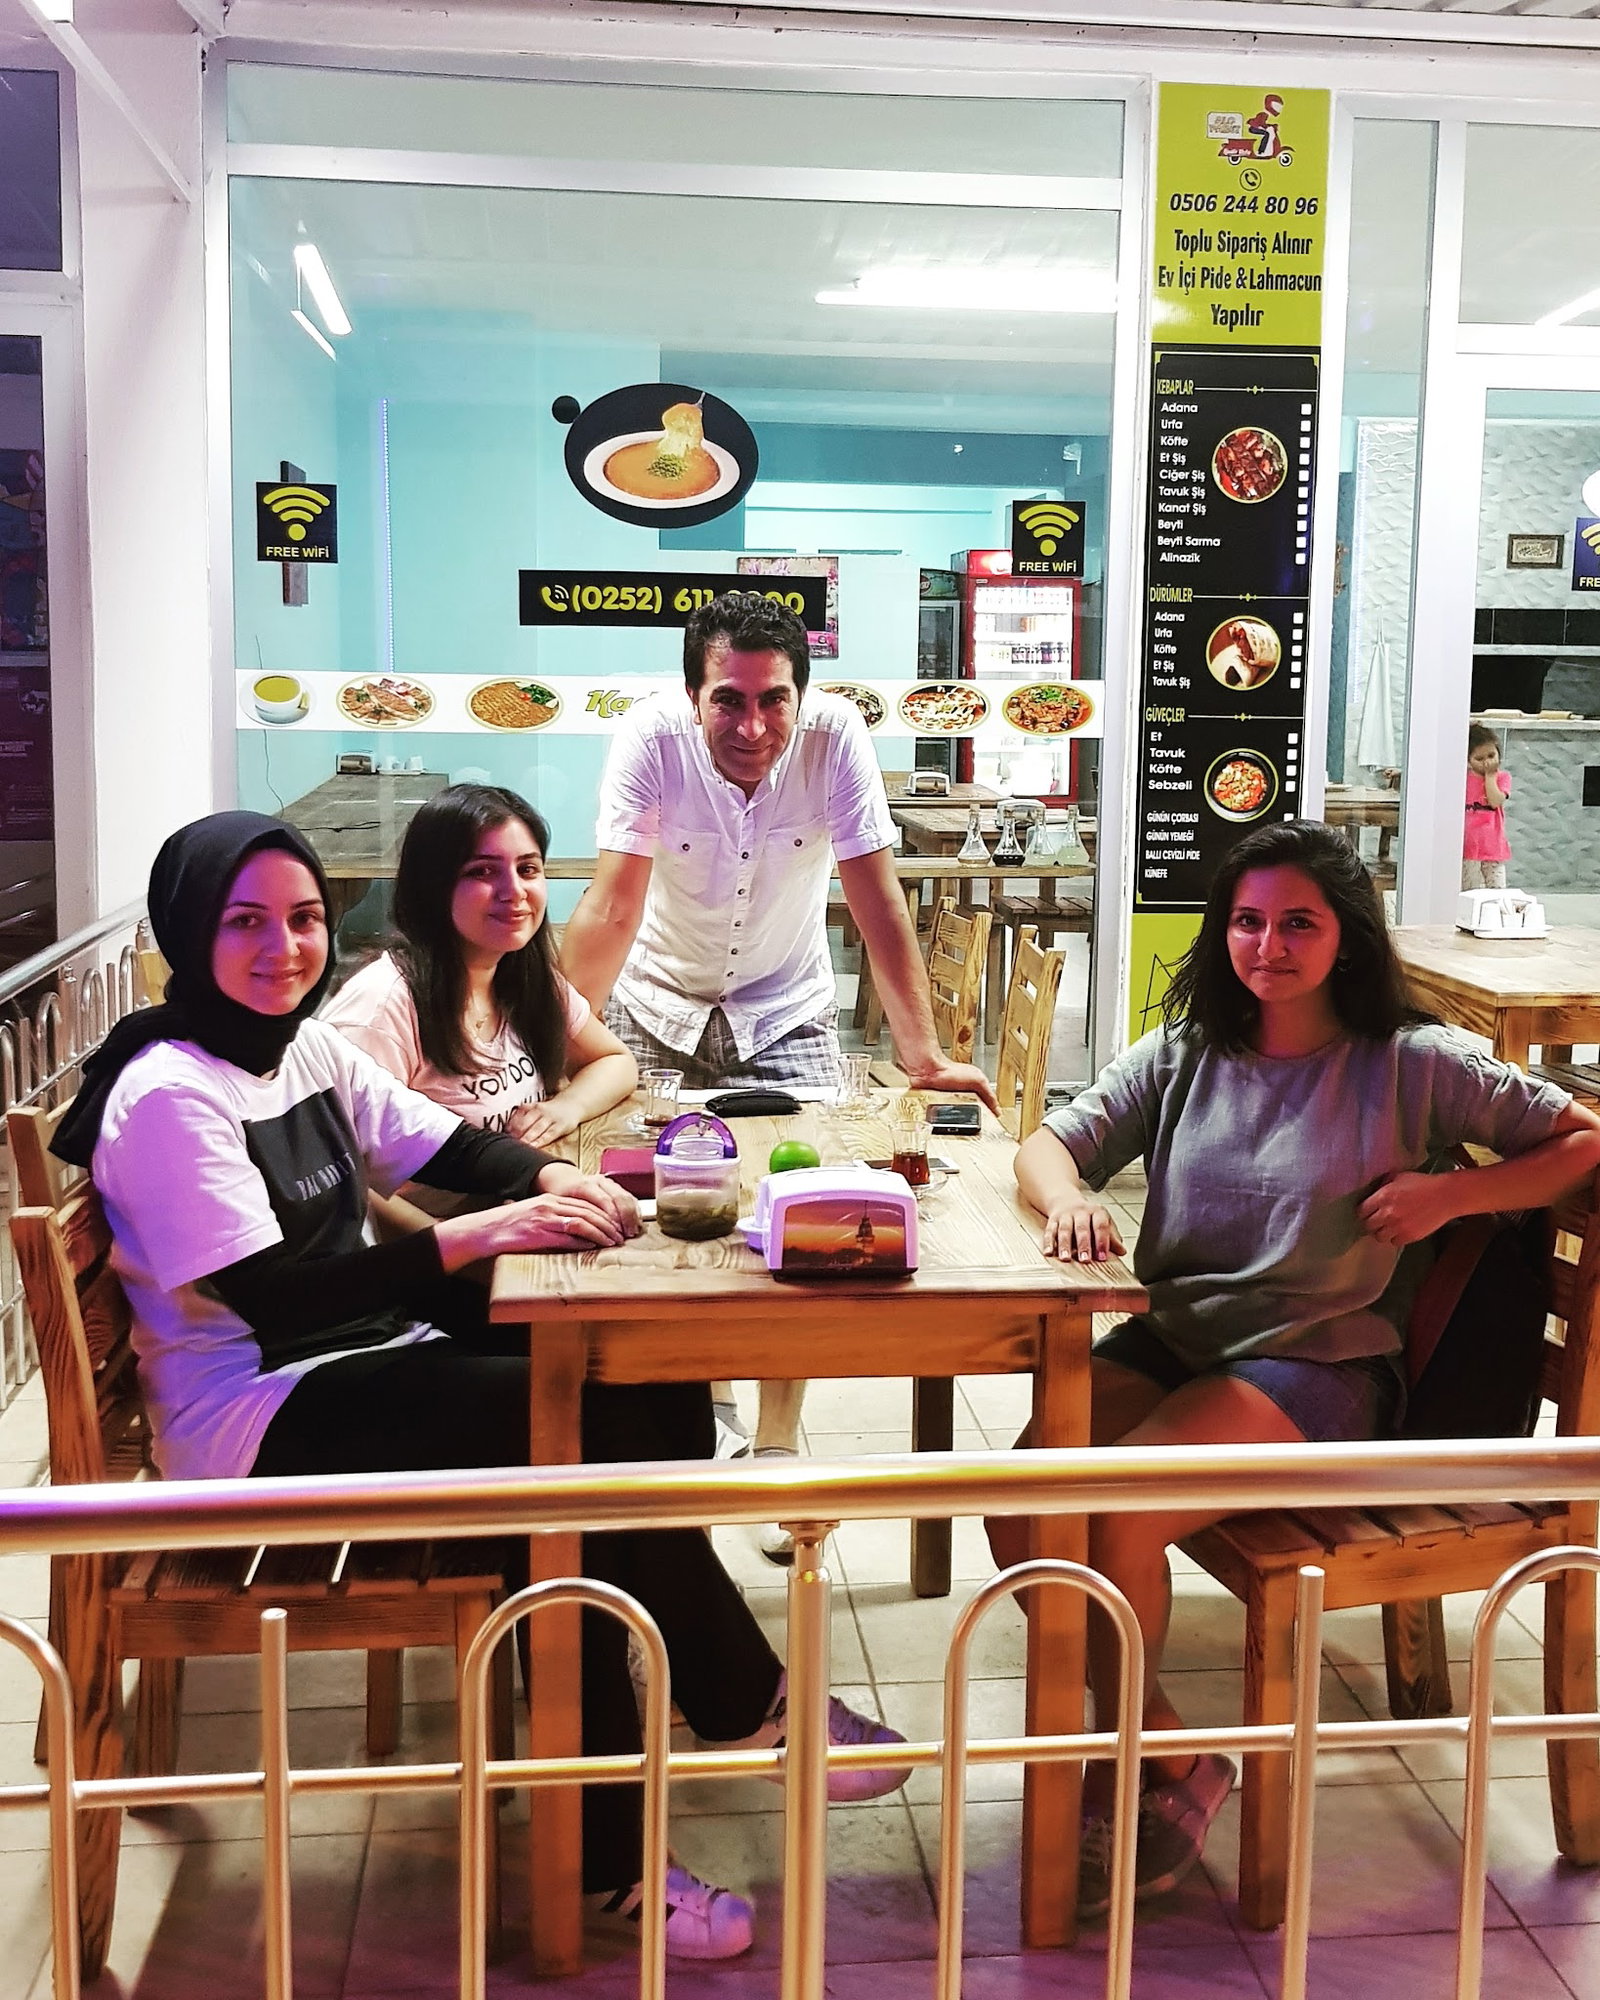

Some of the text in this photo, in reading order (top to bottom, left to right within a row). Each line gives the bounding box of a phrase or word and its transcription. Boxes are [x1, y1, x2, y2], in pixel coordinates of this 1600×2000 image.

[1170, 193, 1318, 216] 0506 244 80 96
[1174, 228, 1313, 261] Toplu Sipariş Alınır
[1158, 265, 1174, 288] Ev
[1201, 265, 1231, 290] Pide
[1211, 303, 1264, 332] Yapılır
[1156, 378, 1194, 395] KEBAPLAR
[1160, 402, 1199, 413] Adana
[1160, 419, 1183, 430] Urfa
[1160, 435, 1189, 447] Köfte
[1160, 452, 1187, 466] Et Şiş
[1159, 469, 1206, 483] Ciğer Şiş
[1158, 486, 1206, 500] Tavuk Şiş
[1158, 502, 1207, 516] Kanat Şiş
[1158, 519, 1184, 532] Beyti
[1157, 535, 1221, 548] Beyti Sarma
[266, 546, 300, 557] FREE
[1019, 561, 1050, 572] FREE
[572, 584, 662, 614] (0252)
[1150, 583, 1193, 603] DÜRÜMLER
[1154, 612, 1185, 622] Adana
[1154, 628, 1173, 638] Urfa
[1153, 643, 1177, 655] Köfte
[1153, 660, 1175, 673] Et Şiş
[1152, 676, 1191, 689] Tavuk Şiş
[1145, 704, 1185, 727] GÜVEÇLER
[1150, 731, 1163, 742] Et
[1149, 747, 1186, 759] Tavuk
[1149, 763, 1183, 775] Köfte
[1148, 779, 1193, 791] Sebzeli
[1146, 810, 1170, 823] GÜNÜN
[1145, 829, 1170, 841] GÜNÜN
[1144, 866, 1168, 879] KÜNEFE
